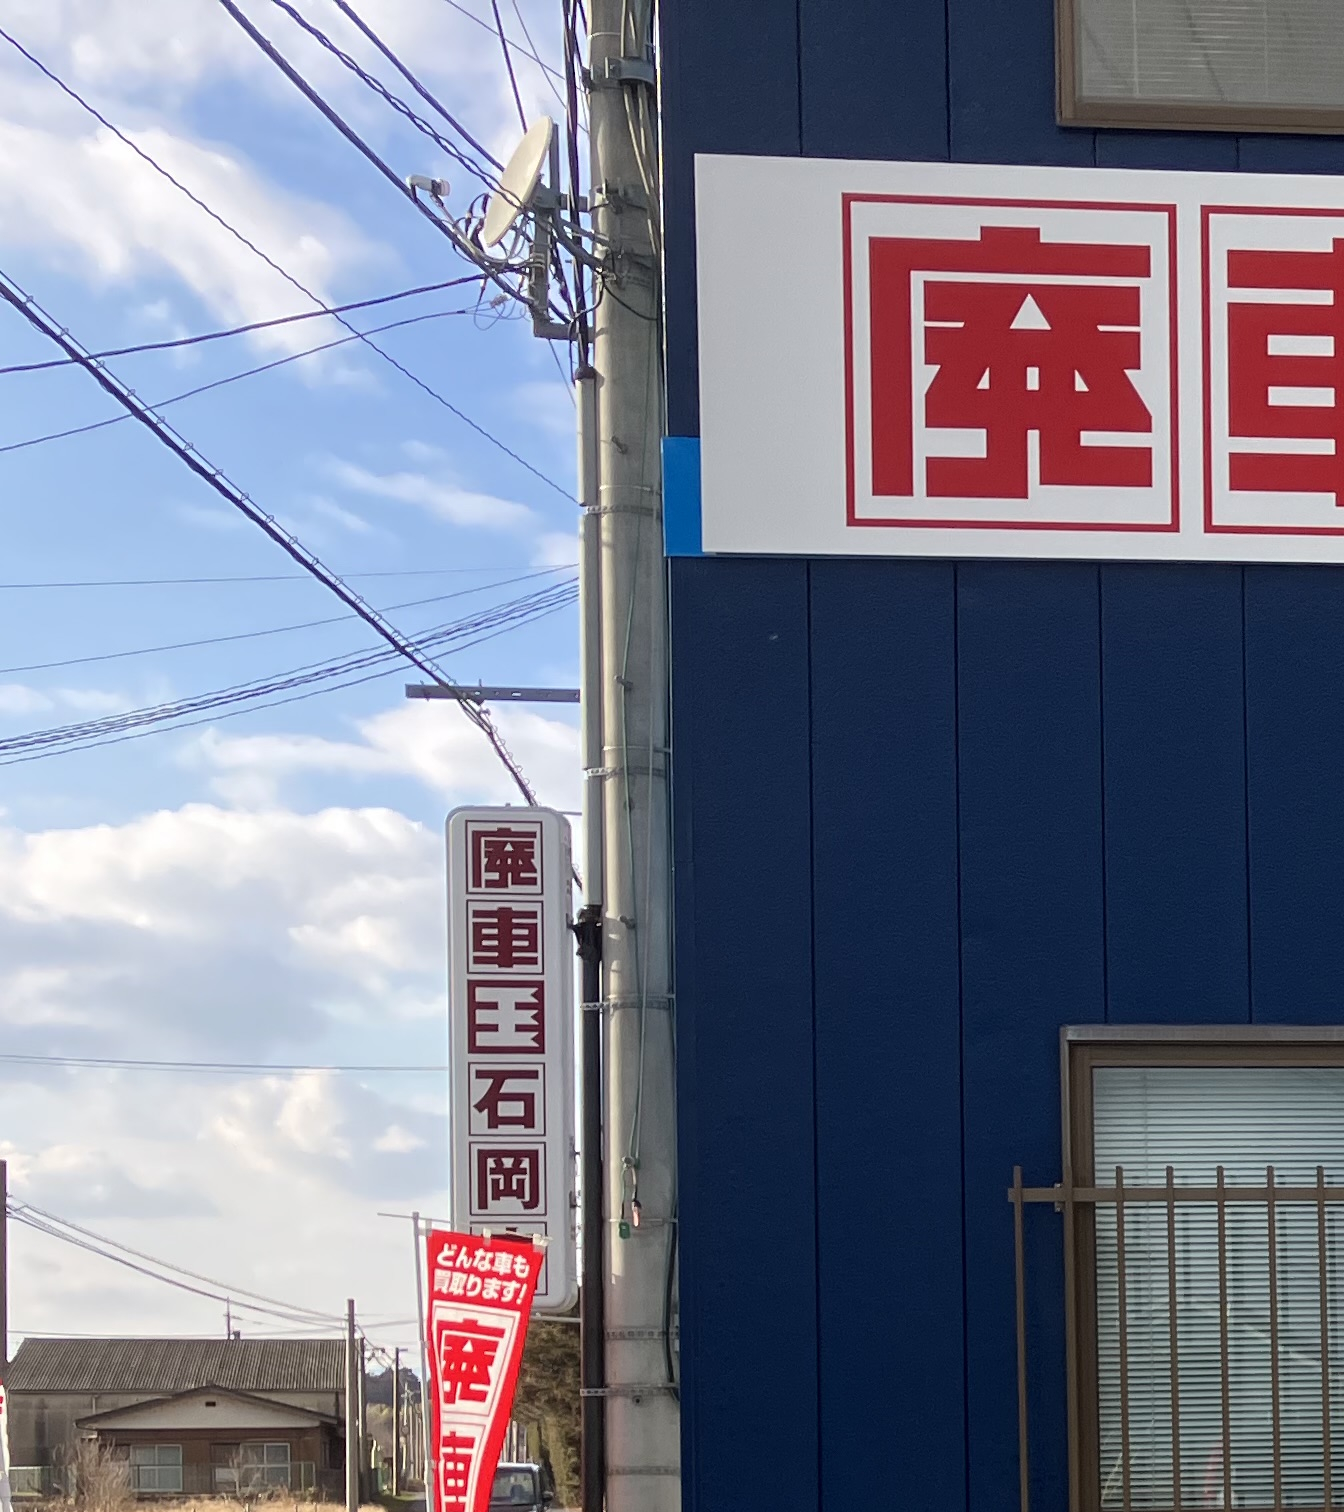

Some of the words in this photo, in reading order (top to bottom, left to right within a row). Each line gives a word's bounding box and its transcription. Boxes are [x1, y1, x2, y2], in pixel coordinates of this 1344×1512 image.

[470, 826, 546, 1244] 廃車王石岡
[437, 1242, 530, 1278] どんな車も
